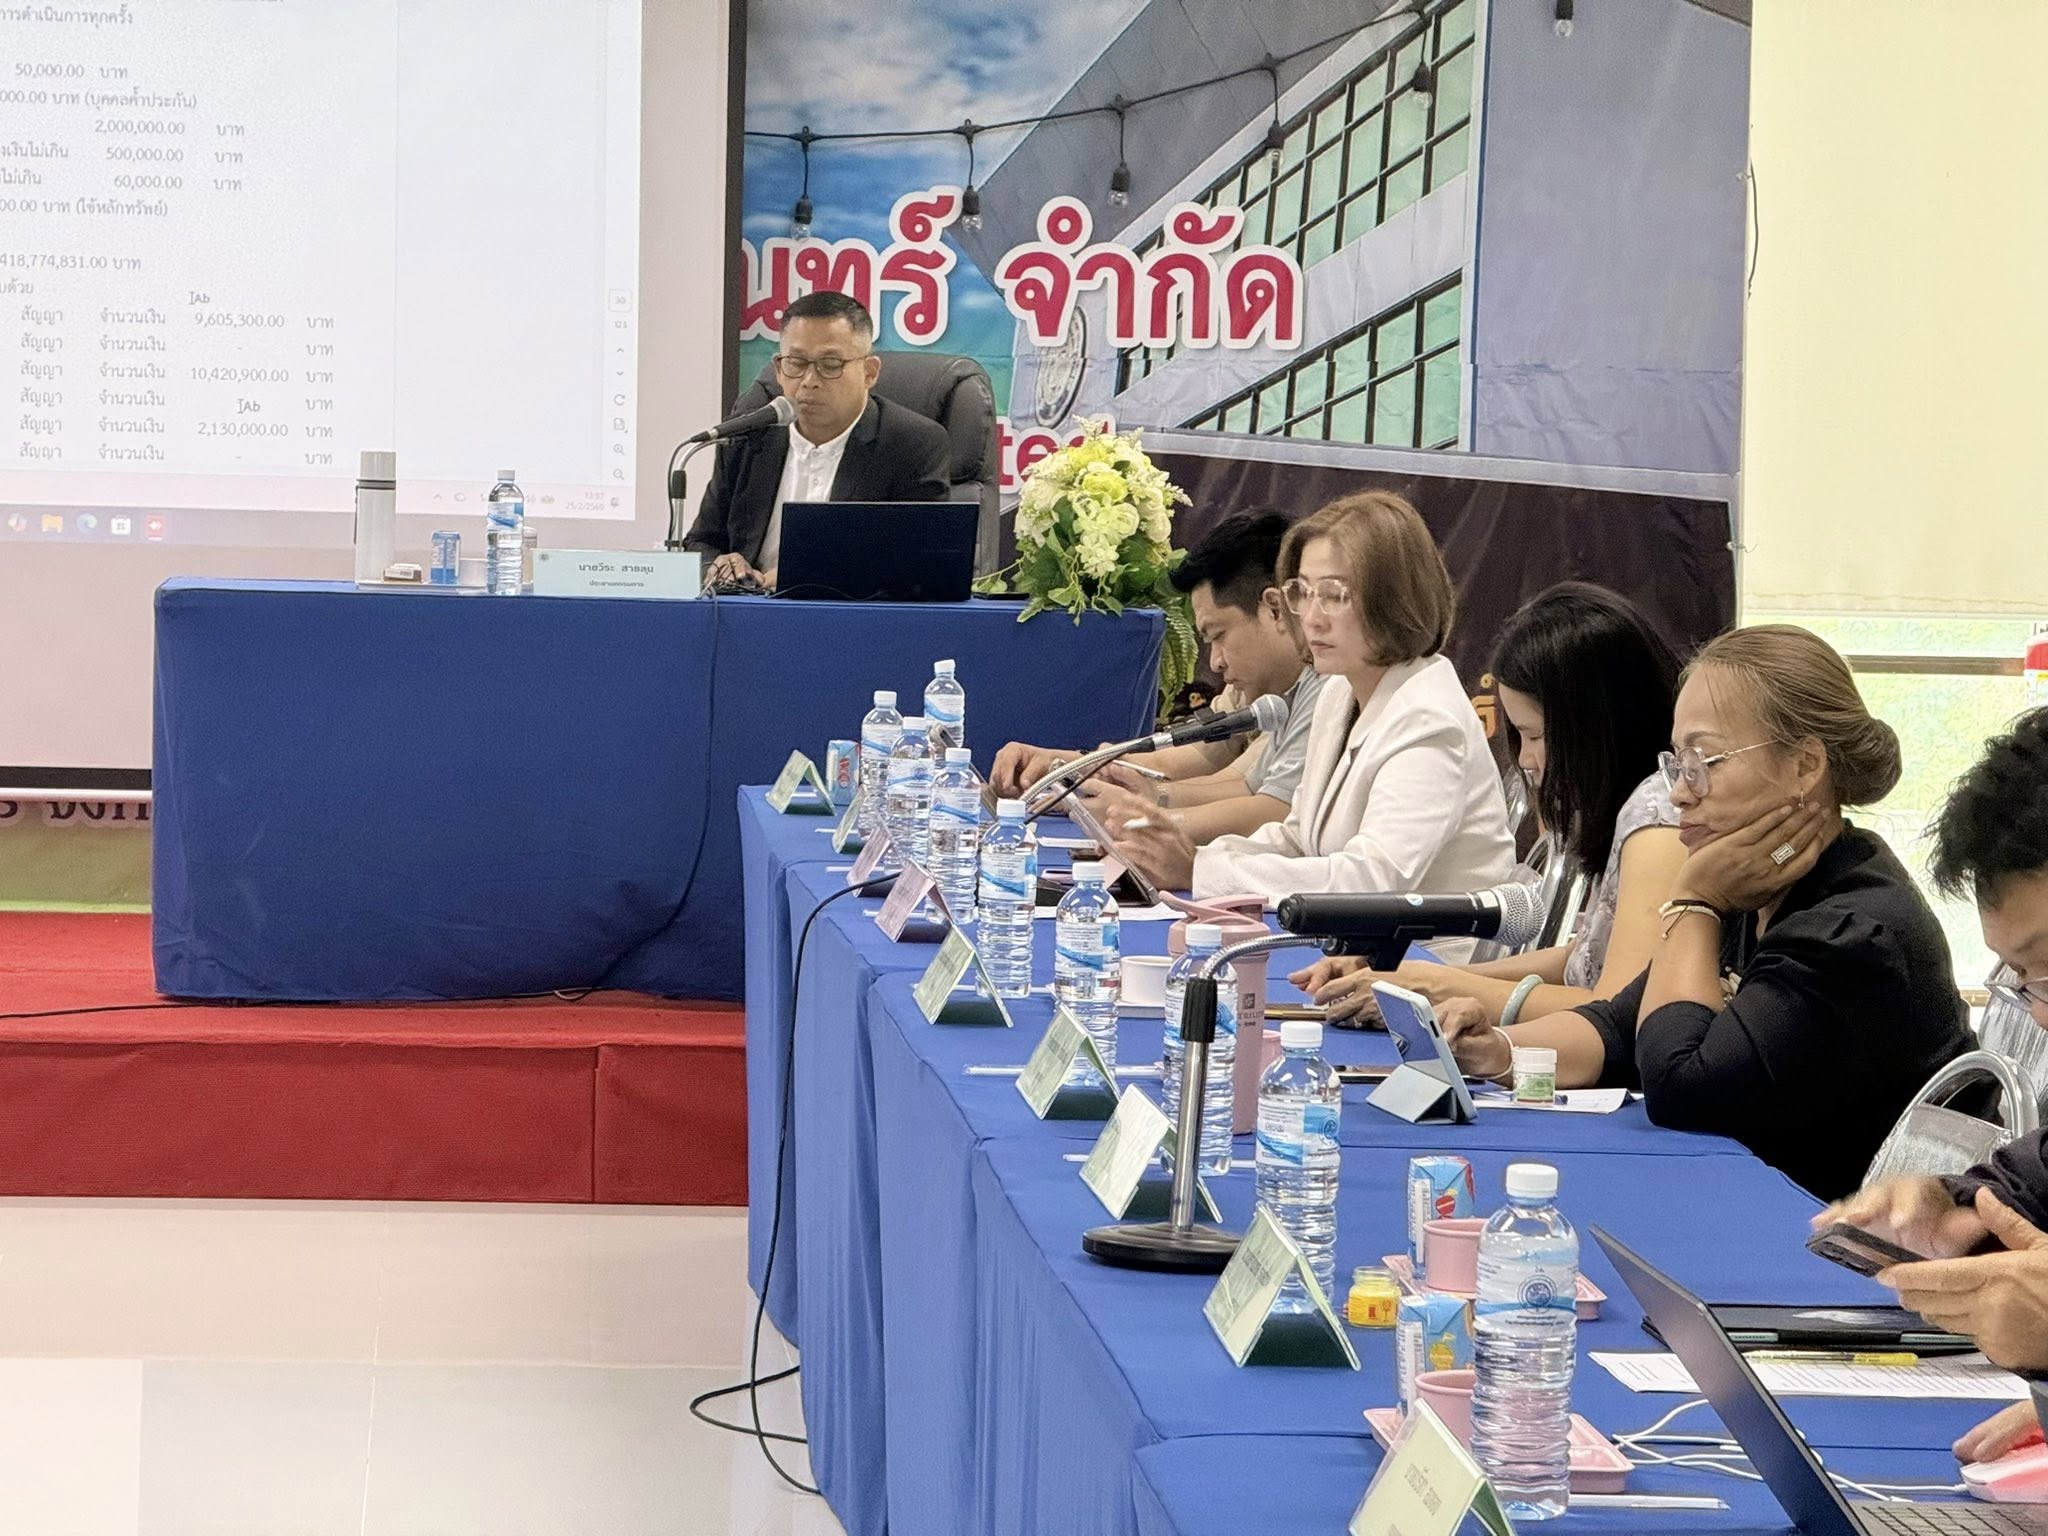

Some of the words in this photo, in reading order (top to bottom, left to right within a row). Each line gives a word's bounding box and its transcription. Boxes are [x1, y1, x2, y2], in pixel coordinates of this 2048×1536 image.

[15, 63, 85, 79] 50,000.00
[100, 65, 128, 79] บาท
[52, 92, 80, 105] บาท
[95, 119, 185, 135] 2,000,000.00
[217, 123, 244, 136] บาท
[106, 147, 184, 162] 500,000.00
[215, 150, 243, 163] บาท
[114, 175, 183, 190] 60,000.00
[214, 177, 242, 191] บาท
[44, 201, 70, 214] บาท
[113, 256, 141, 270] บาท
[1002, 205, 1294, 341] จำกัด
[21, 305, 63, 326] สัญญา
[100, 308, 166, 325] จำนวนเงิน
[195, 313, 285, 329] 9,605,300.00
[306, 315, 334, 329] บาท
[21, 333, 63, 353] สัญญา
[100, 335, 166, 352] จำนวนเงิน
[306, 343, 334, 357] บาท
[20, 360, 63, 380] สัญญา
[100, 363, 166, 379] จำนวนเงิน
[191, 367, 289, 383] 10,420,900.00
[306, 370, 334, 383] บาท
[20, 387, 63, 408] สัญญา
[99, 390, 165, 406] จำนวนเงิน
[306, 397, 333, 411] บาท
[20, 414, 62, 435] สัญญา
[99, 418, 165, 434] จำนวนเงิน
[198, 422, 288, 438] 2,130,000.00
[306, 424, 333, 438] บาท
[20, 442, 62, 462] สัญญา
[98, 445, 164, 461] จำนวนเงิน
[305, 452, 332, 465] บาท
